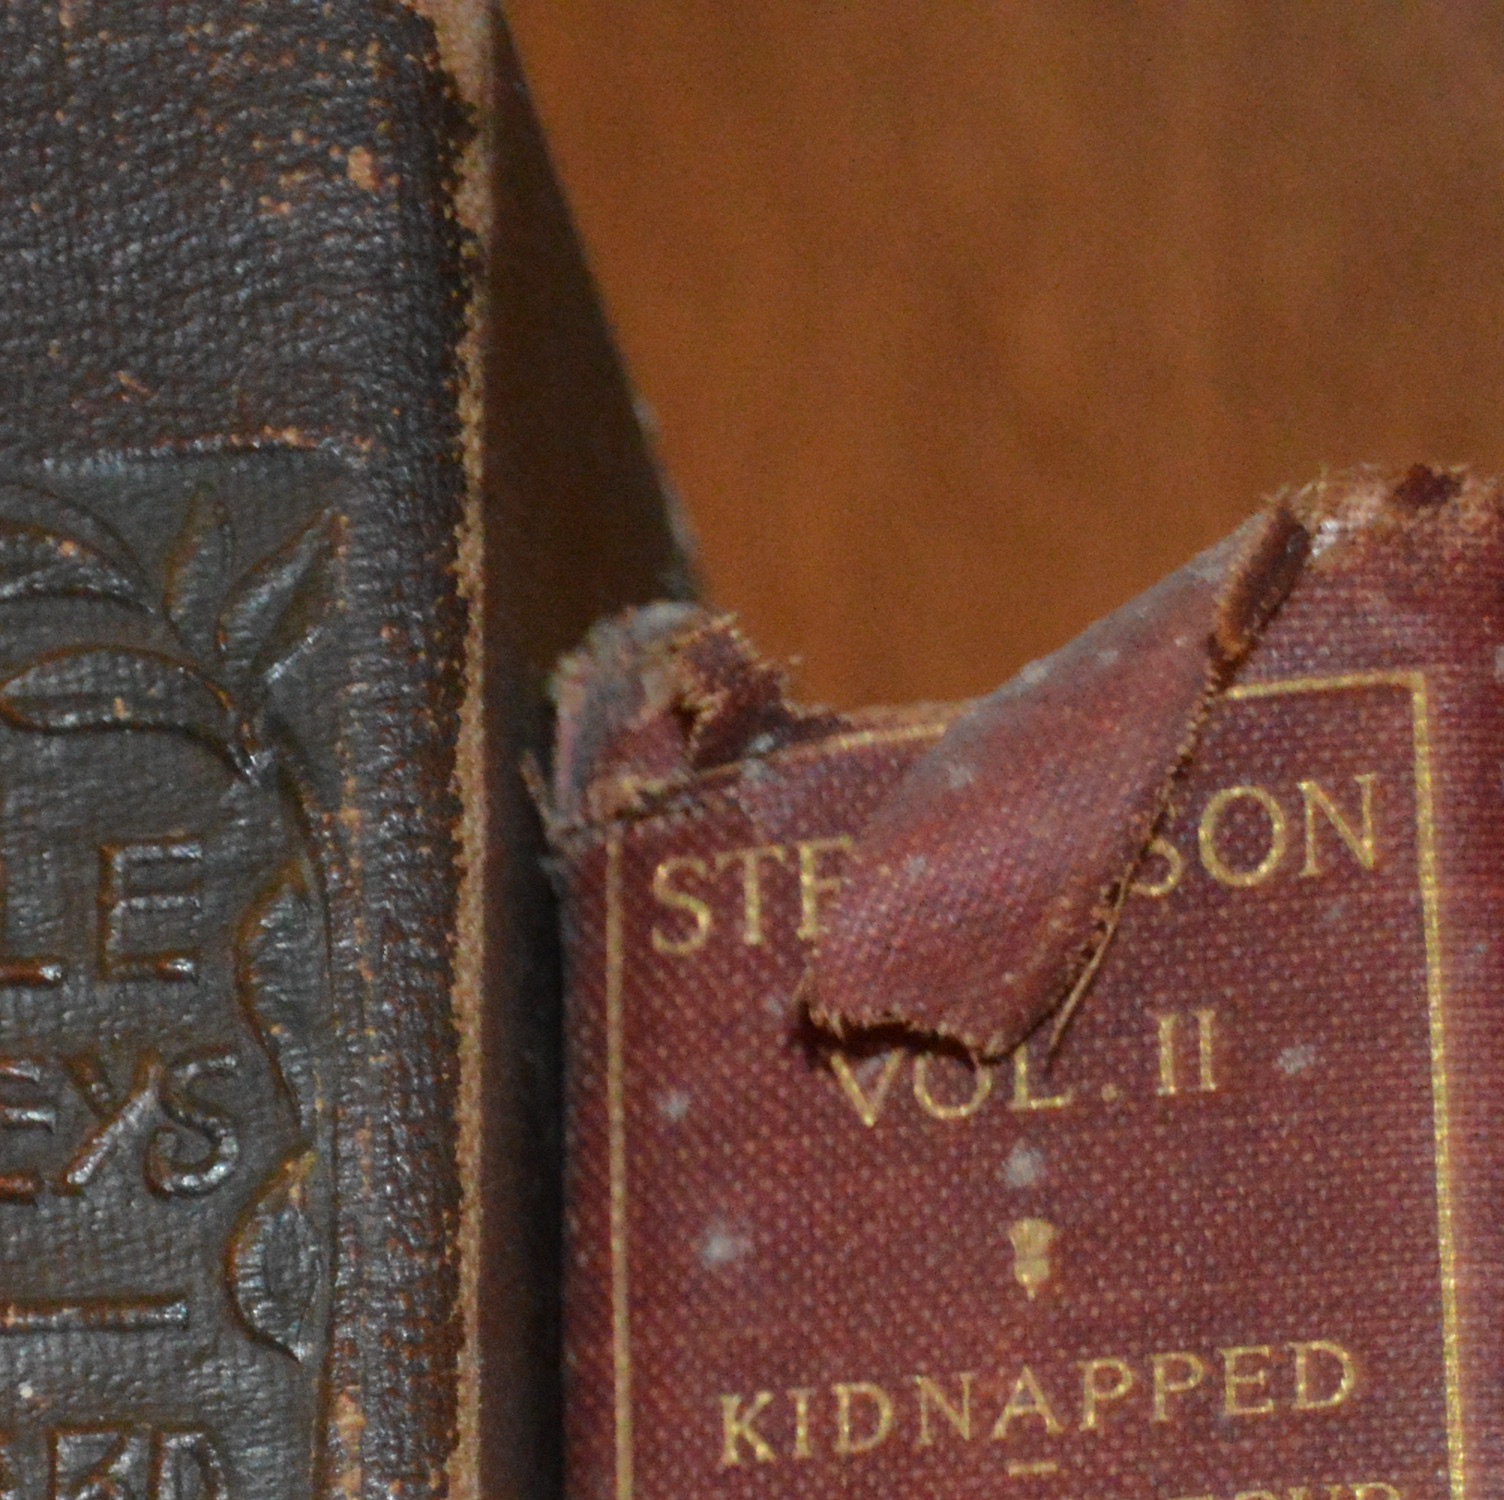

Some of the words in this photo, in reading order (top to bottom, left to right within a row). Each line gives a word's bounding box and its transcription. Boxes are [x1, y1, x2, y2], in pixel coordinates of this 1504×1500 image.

[650, 772, 1382, 960] STESON
[1153, 1008, 1218, 1098] II
[719, 1339, 1357, 1467] KIDNAPPED
